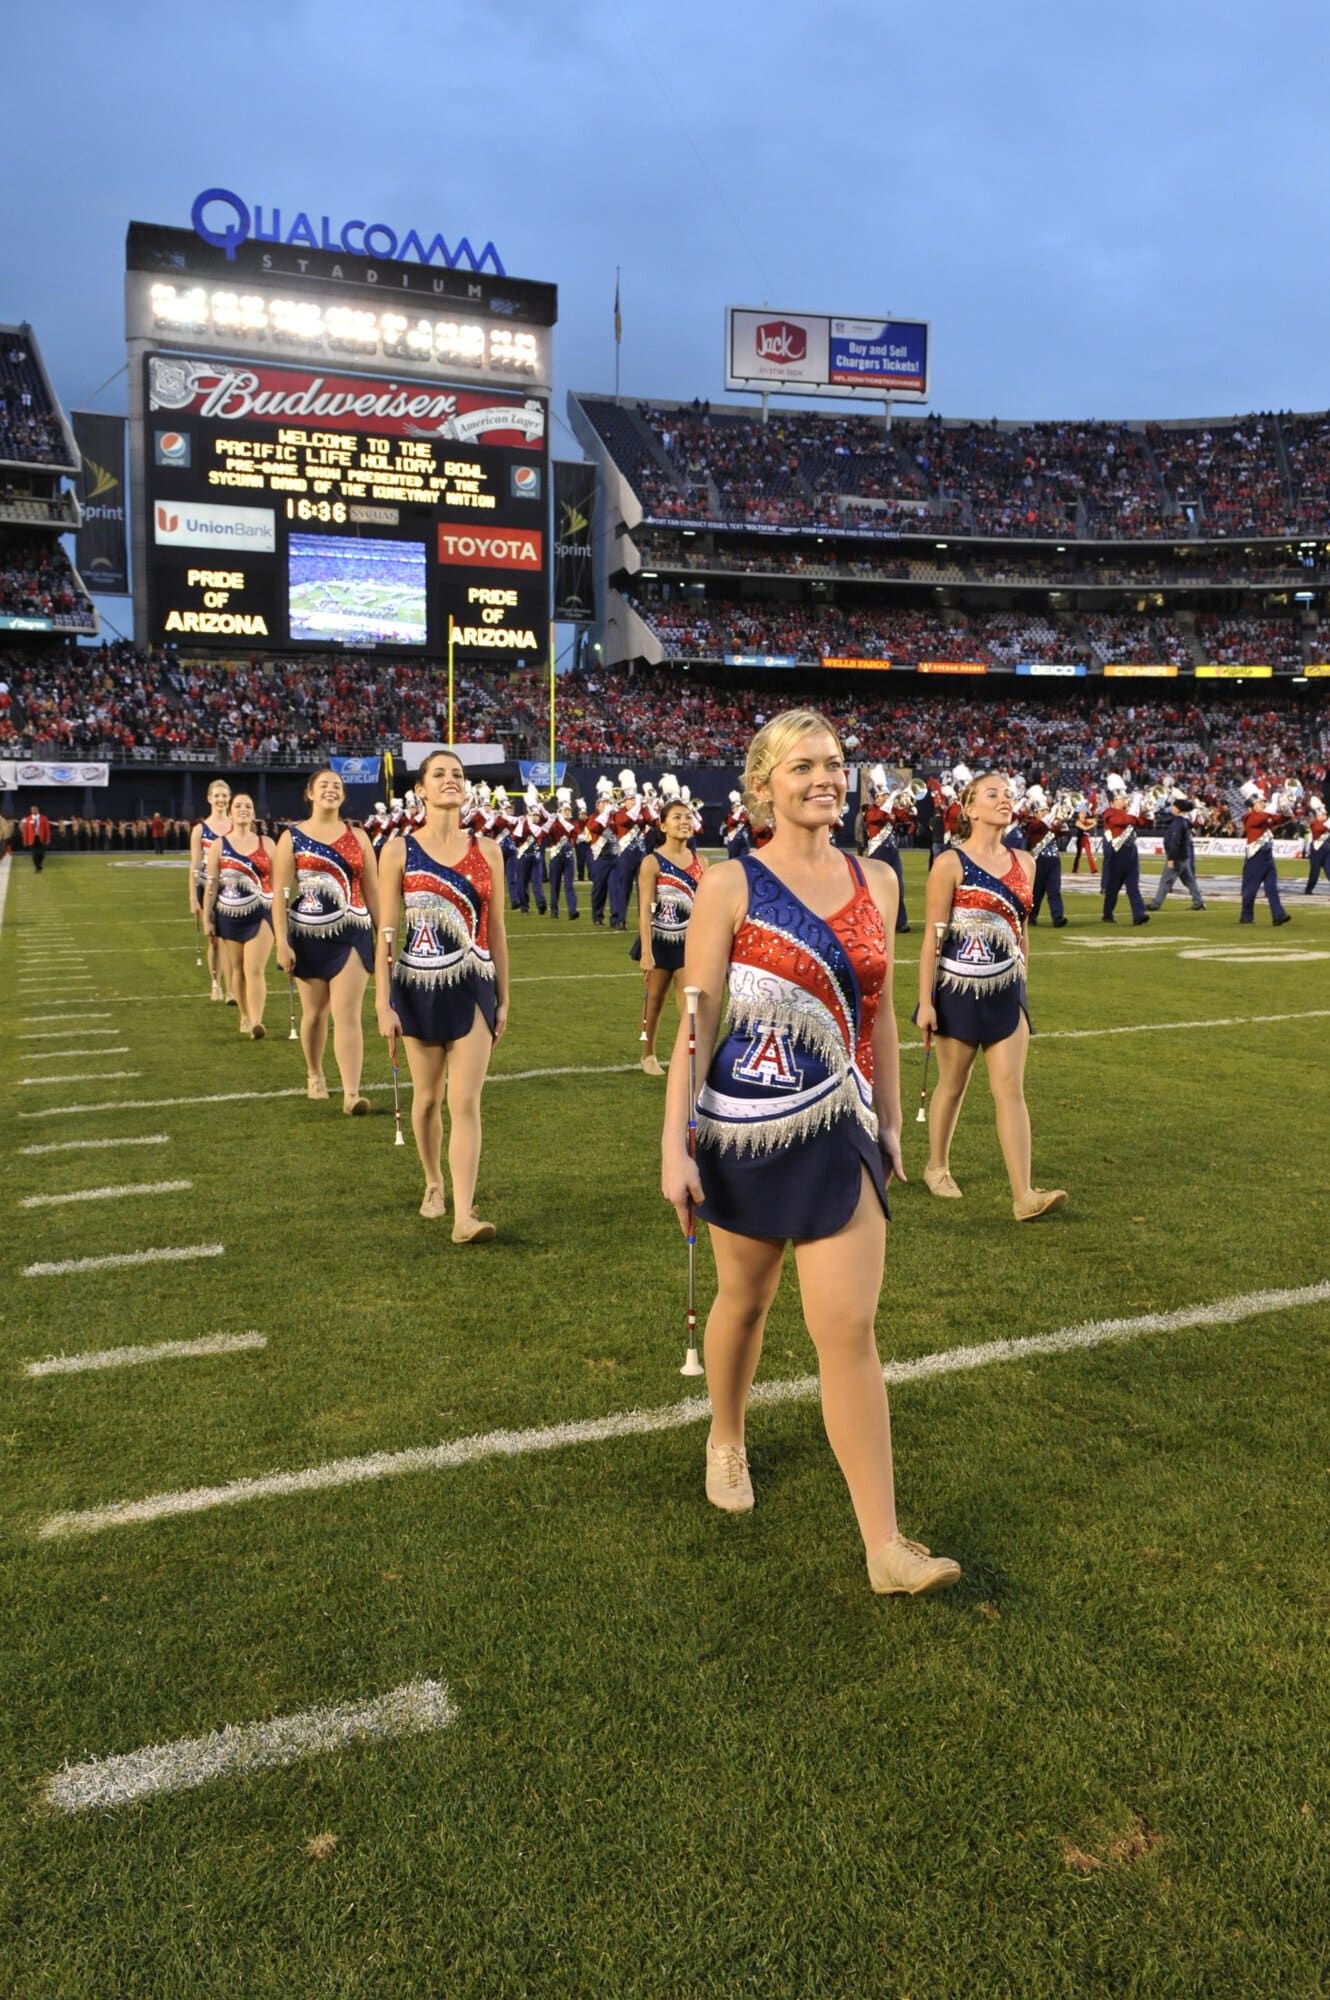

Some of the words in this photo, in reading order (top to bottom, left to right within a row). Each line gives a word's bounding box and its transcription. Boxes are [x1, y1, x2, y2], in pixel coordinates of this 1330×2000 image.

[191, 187, 507, 276] QUALCOMM
[262, 254, 483, 298] STADIUM
[757, 325, 805, 359] Jack
[849, 342, 867, 356] Buy
[869, 345, 887, 356] and
[889, 345, 907, 357] Sell
[836, 355, 880, 370] Chargers
[882, 358, 920, 372] Tickets!
[187, 372, 456, 420] Budweiser
[460, 415, 508, 433] American
[511, 414, 541, 428] Lager
[278, 429, 357, 451] WELCOME
[366, 438, 390, 454] TO
[398, 441, 432, 458] THE
[215, 439, 297, 461] PACIFIC
[305, 448, 352, 466] LIFE
[360, 453, 436, 474] HOLIDAY
[444, 461, 487, 479] BOWL
[226, 458, 298, 476] PRE-GAME
[305, 465, 341, 480] SHOW
[347, 469, 424, 487] PRESENTED
[429, 477, 448, 490] BY
[454, 479, 480, 493] THE
[313, 480, 332, 494] OF
[339, 482, 366, 497] THE
[446, 492, 496, 508] NATION
[80, 502, 124, 521] Sprint
[286, 498, 347, 523] 16:36
[186, 519, 273, 537] UnionBank
[443, 535, 538, 562] TOYOTA
[554, 541, 592, 558] Sprint
[187, 569, 245, 590] PRIDE
[203, 591, 230, 608] OF
[468, 587, 519, 607] PRIDE
[164, 611, 269, 636] ARIZONA
[481, 607, 505, 624] OF
[450, 625, 538, 649] ARIZONA
[823, 658, 857, 669] WELLS
[858, 660, 890, 670] FARGO
[732, 1020, 804, 1091] A
